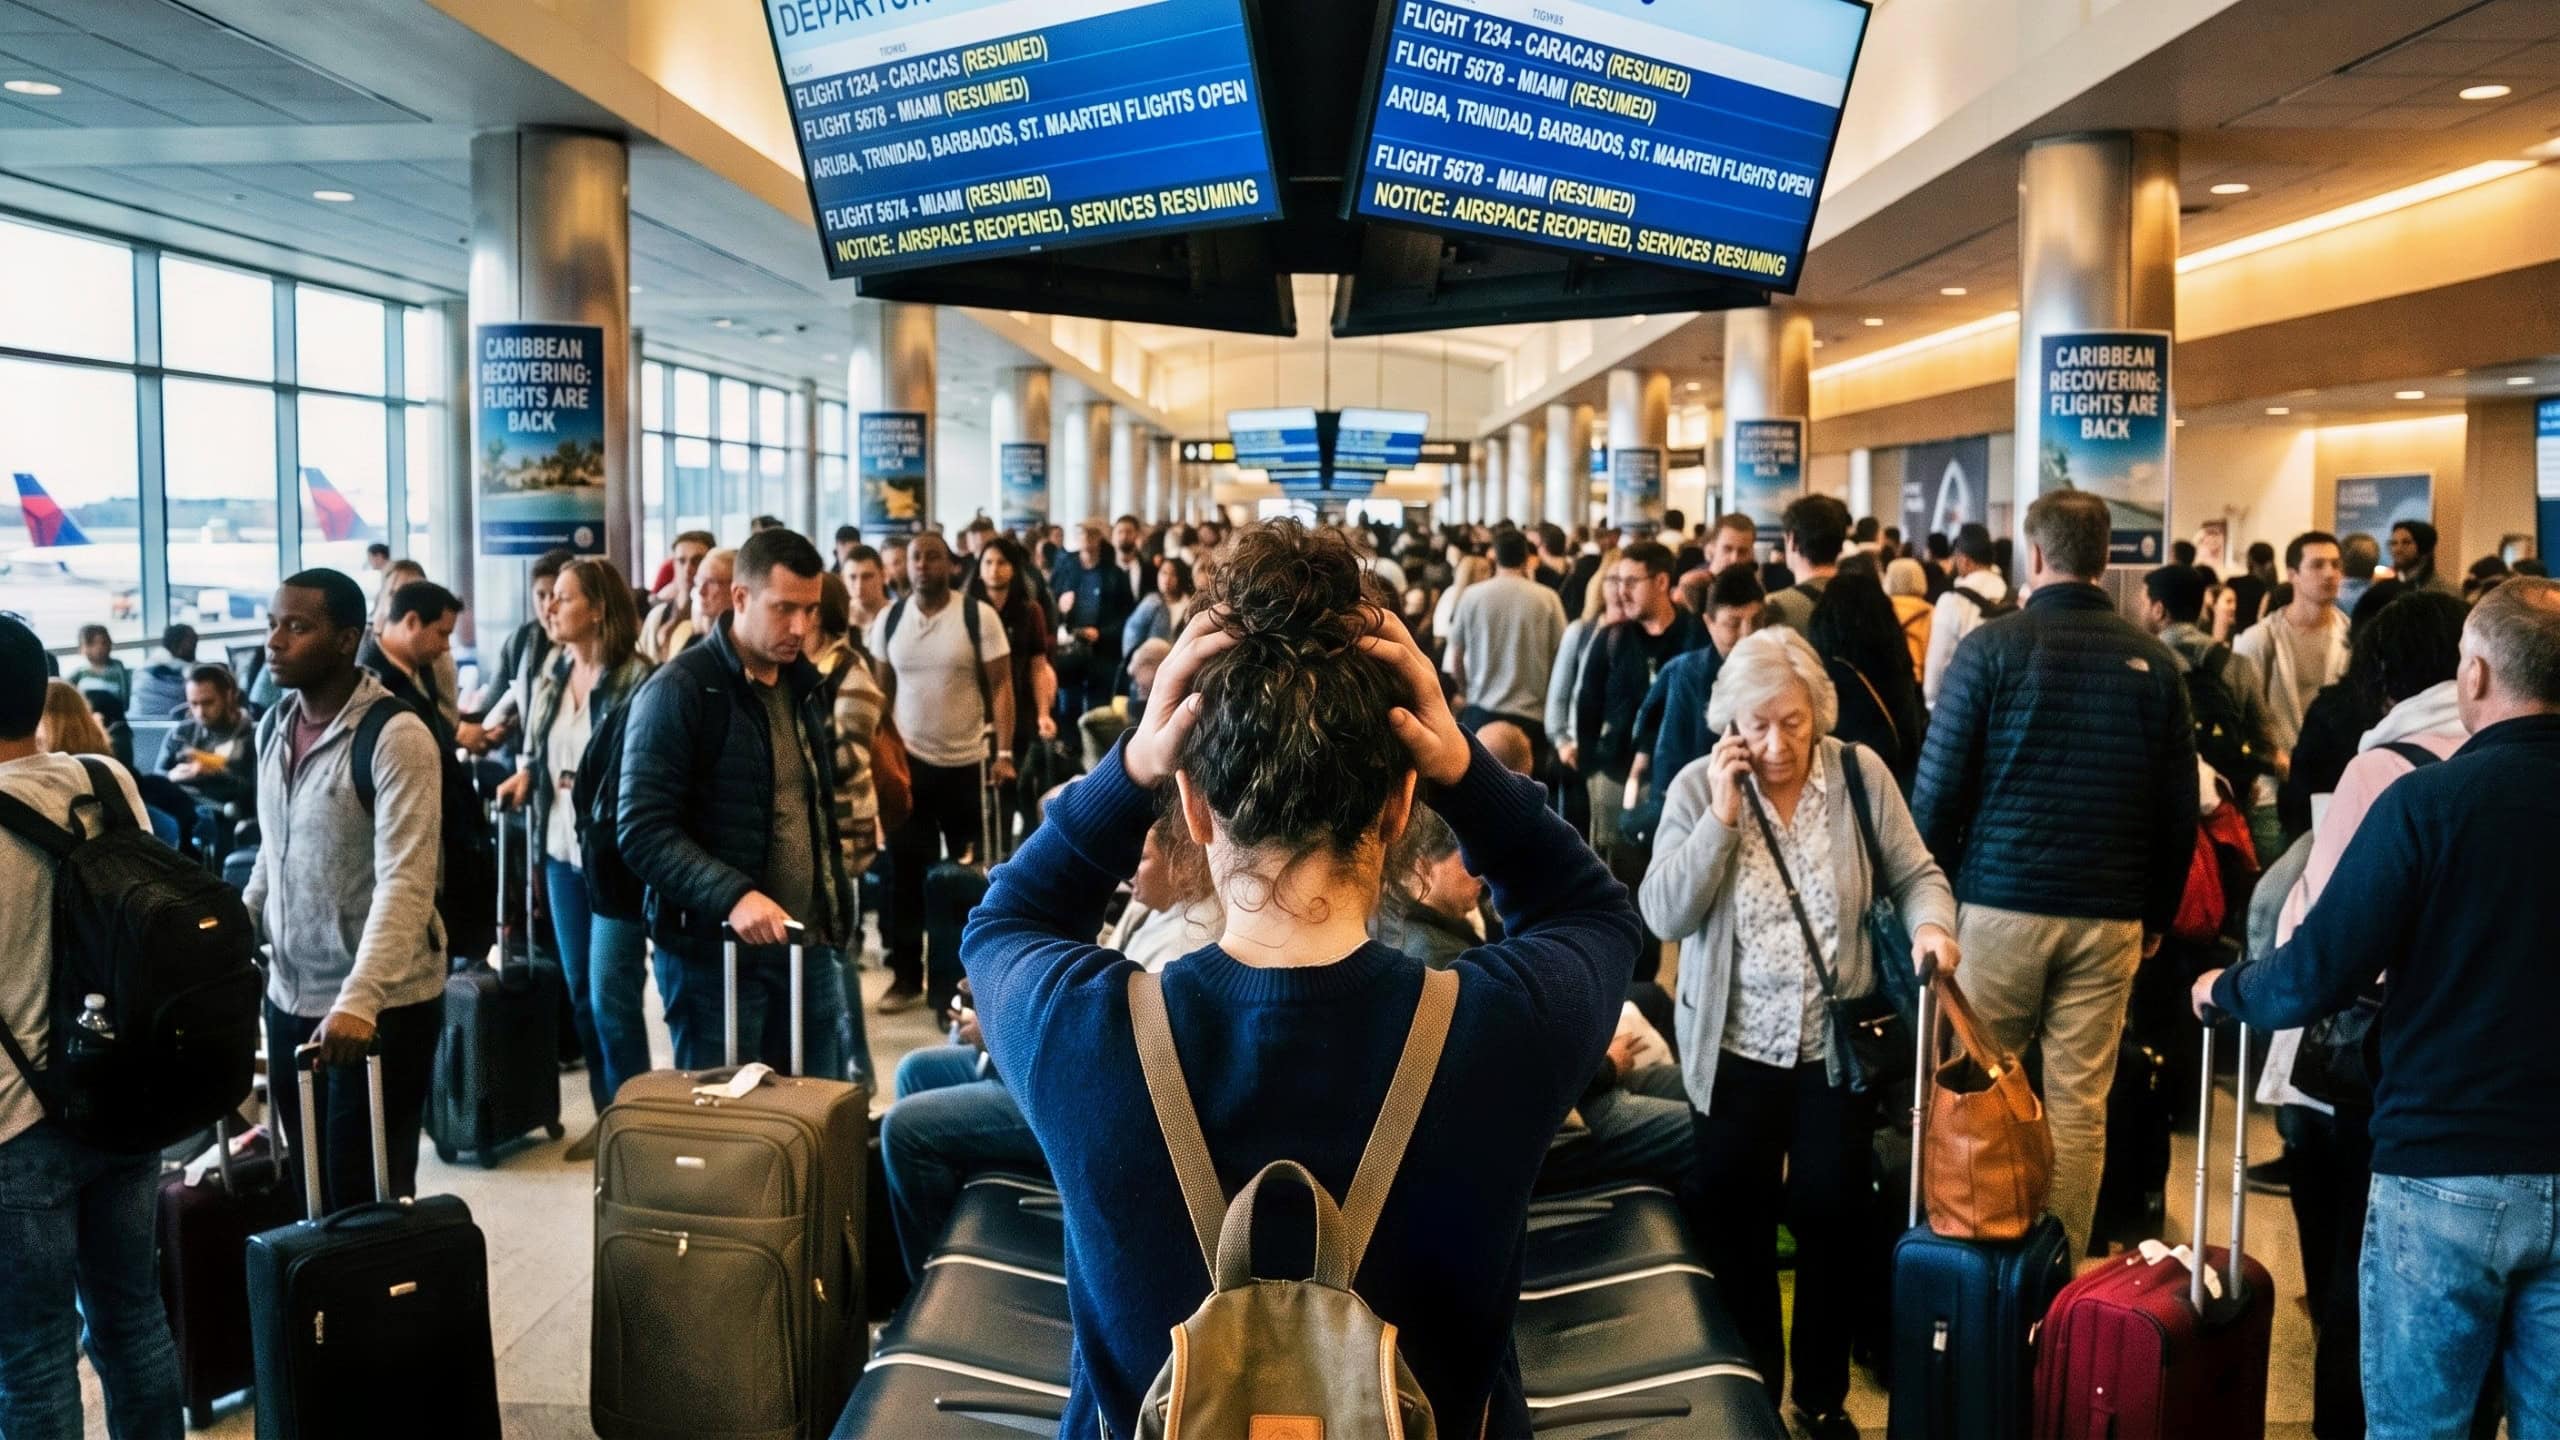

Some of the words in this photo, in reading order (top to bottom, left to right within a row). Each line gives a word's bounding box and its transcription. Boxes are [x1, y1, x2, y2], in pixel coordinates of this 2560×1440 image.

[779, 0, 929, 37] DEPAR
[795, 80, 843, 109] FLIGHT
[847, 72, 879, 97] 1234
[889, 54, 960, 88] CARACAS
[962, 35, 1048, 77] (RESUMED)
[1403, 2, 1470, 38] FLIGHT
[1474, 19, 1512, 48] 1234
[1525, 33, 1605, 72] CARACAS
[1607, 54, 1691, 98] (RESUMED)
[803, 112, 851, 141] FLIGHT
[855, 106, 887, 131] 5678
[897, 94, 942, 122] MIAMI
[944, 76, 1029, 117] (RESUMED)
[1396, 40, 1463, 75] FLIGHT
[1465, 57, 1505, 85] 5678
[1517, 69, 1568, 100] MIAMI
[1570, 82, 1656, 125] (RESUMED)
[814, 153, 863, 179] ARUBA,
[862, 139, 931, 169] TRINIDAD,
[931, 122, 1017, 157] BARBADOS,
[1019, 117, 1043, 141] ST.
[1045, 102, 1123, 136] MAARTEN
[1125, 88, 1195, 122] FLIGHTS
[1198, 79, 1247, 109] OPEN
[1386, 85, 1450, 122] ARUBA,
[1458, 99, 1534, 140] TRINIDAD,
[1538, 118, 1625, 160] BARBADOS,
[1629, 138, 1650, 161] ST.
[1653, 143, 1721, 176] MAARTEN
[1722, 159, 1777, 189] FLIGHTS
[1778, 172, 1814, 197] OPEN
[825, 204, 873, 230] FLIGHT
[919, 189, 963, 216] MIAMI
[966, 175, 1051, 213] (RESUMED)
[1375, 144, 1442, 176] FLIGHT
[1443, 158, 1484, 185] 5678
[1497, 168, 1547, 197] MIAMI
[1549, 179, 1635, 218] (RESUMED)
[836, 234, 895, 261] NOTICE:
[899, 222, 973, 253] AIRSPACE
[974, 209, 1069, 241] REOPENED,
[1071, 194, 1156, 228] SERVICES
[1160, 179, 1258, 215] RESUMING
[1374, 182, 1449, 216] NOTICE:
[1452, 197, 1540, 232] AIRSPACE
[1543, 212, 1632, 252] REOPENED,
[1637, 230, 1711, 262] SERVICES
[1713, 244, 1786, 276] RESUMING
[482, 362, 592, 385] RECOVERING:
[486, 337, 583, 359] CARIBBEAN
[2056, 346, 2155, 368] CARIBBEAN
[483, 386, 548, 409] FLIGHTS
[552, 387, 589, 409] ARE
[2049, 370, 2161, 393] RECOVERING:
[2051, 394, 2123, 416] FLIGHTS
[2127, 395, 2158, 416] ARE
[508, 410, 556, 433] BACK
[2081, 418, 2130, 440] BACK
